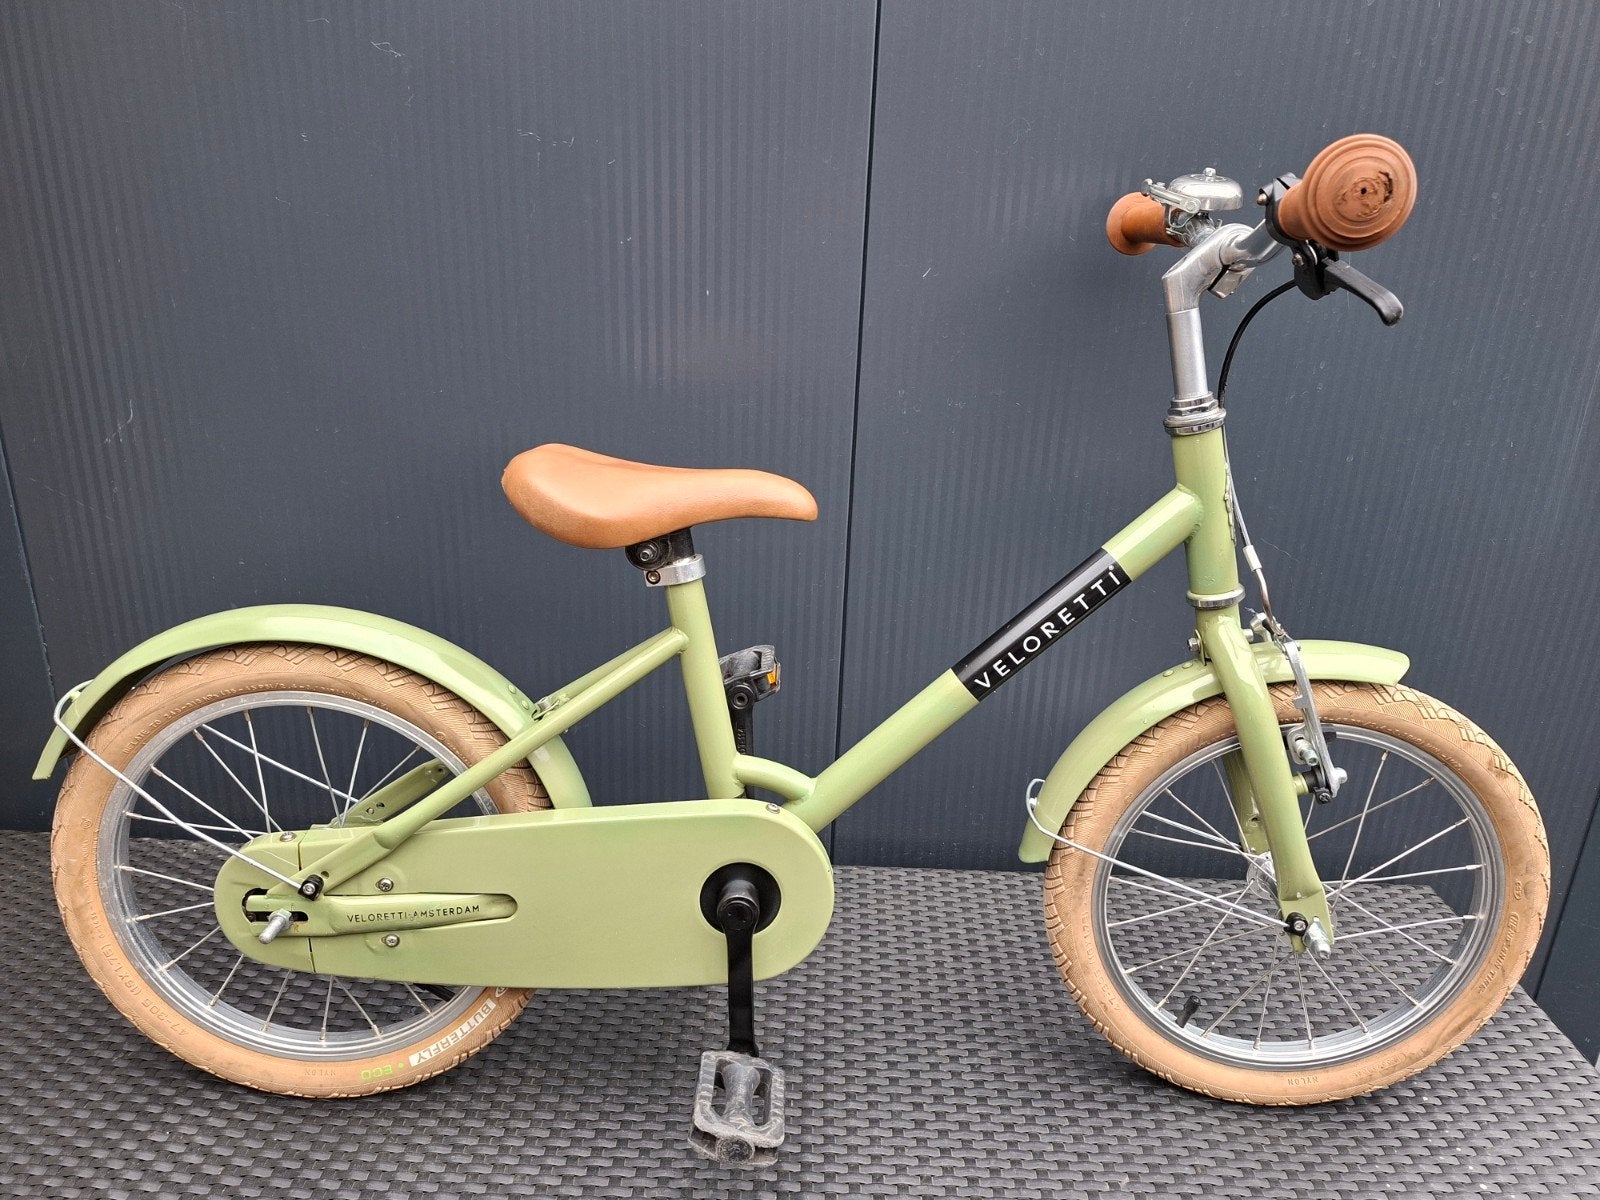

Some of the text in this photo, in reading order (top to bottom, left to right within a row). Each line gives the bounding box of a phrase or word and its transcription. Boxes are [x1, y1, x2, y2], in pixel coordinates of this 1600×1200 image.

[347, 904, 481, 923] VELORETTI AMSTERDAM
[360, 1001, 492, 1081] BUTTERFLY ECO
